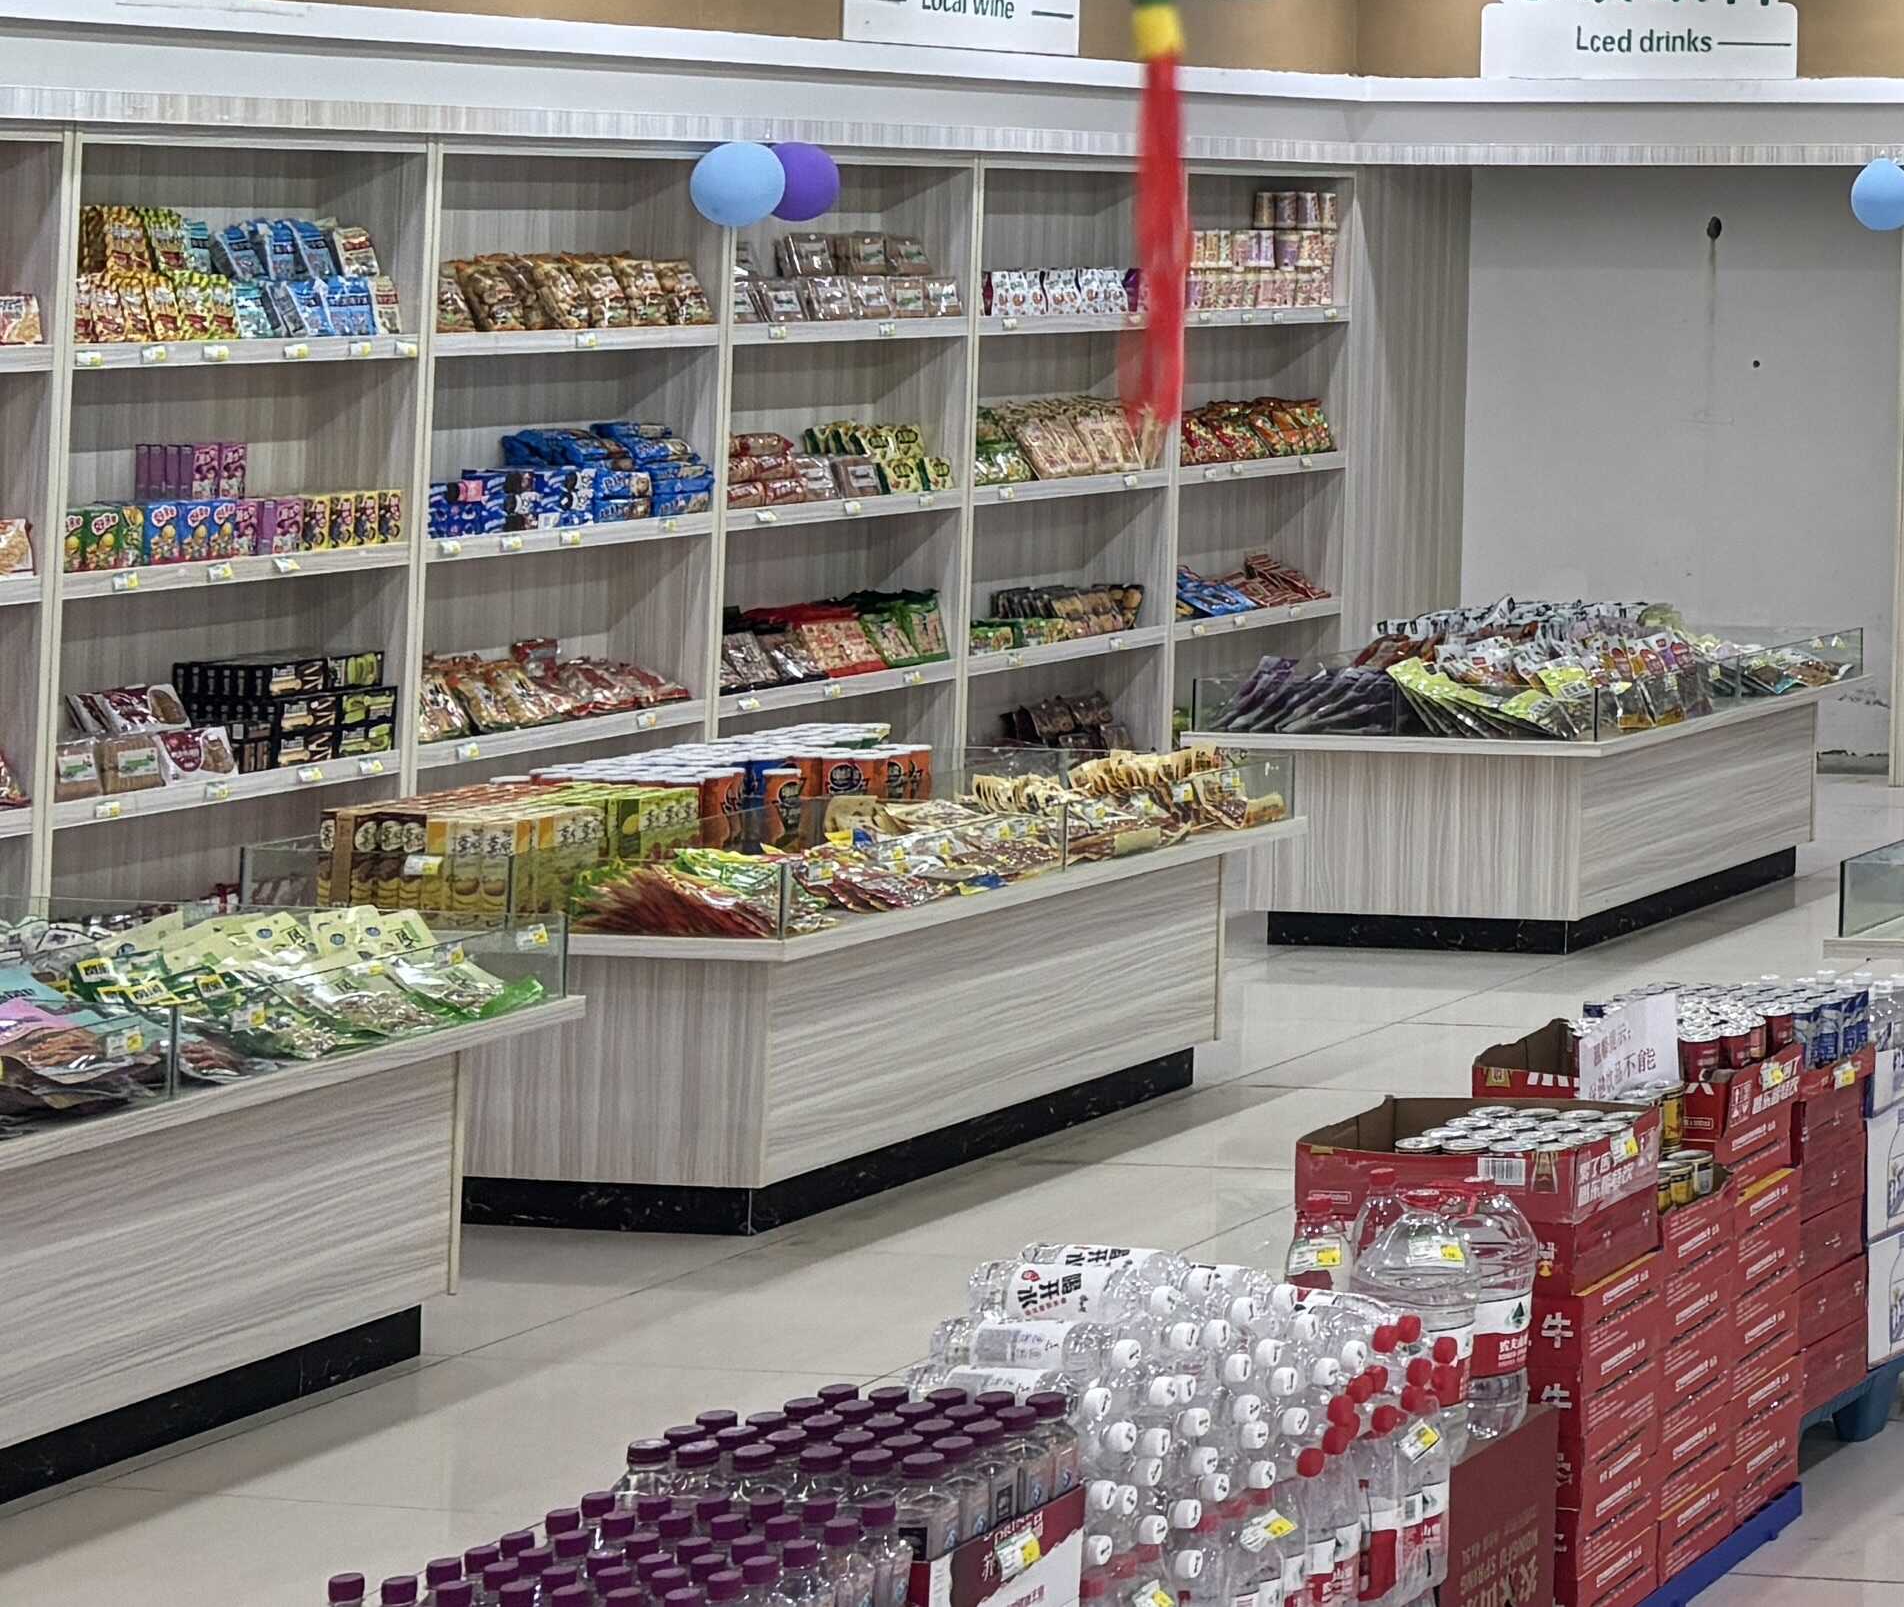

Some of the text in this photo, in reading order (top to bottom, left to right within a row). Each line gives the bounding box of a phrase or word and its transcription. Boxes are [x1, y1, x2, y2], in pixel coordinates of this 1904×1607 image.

[1576, 26, 1713, 54] Lced drinks
[1016, 1272, 1082, 1309] 喝开水
[1541, 1312, 1574, 1348] 牛
